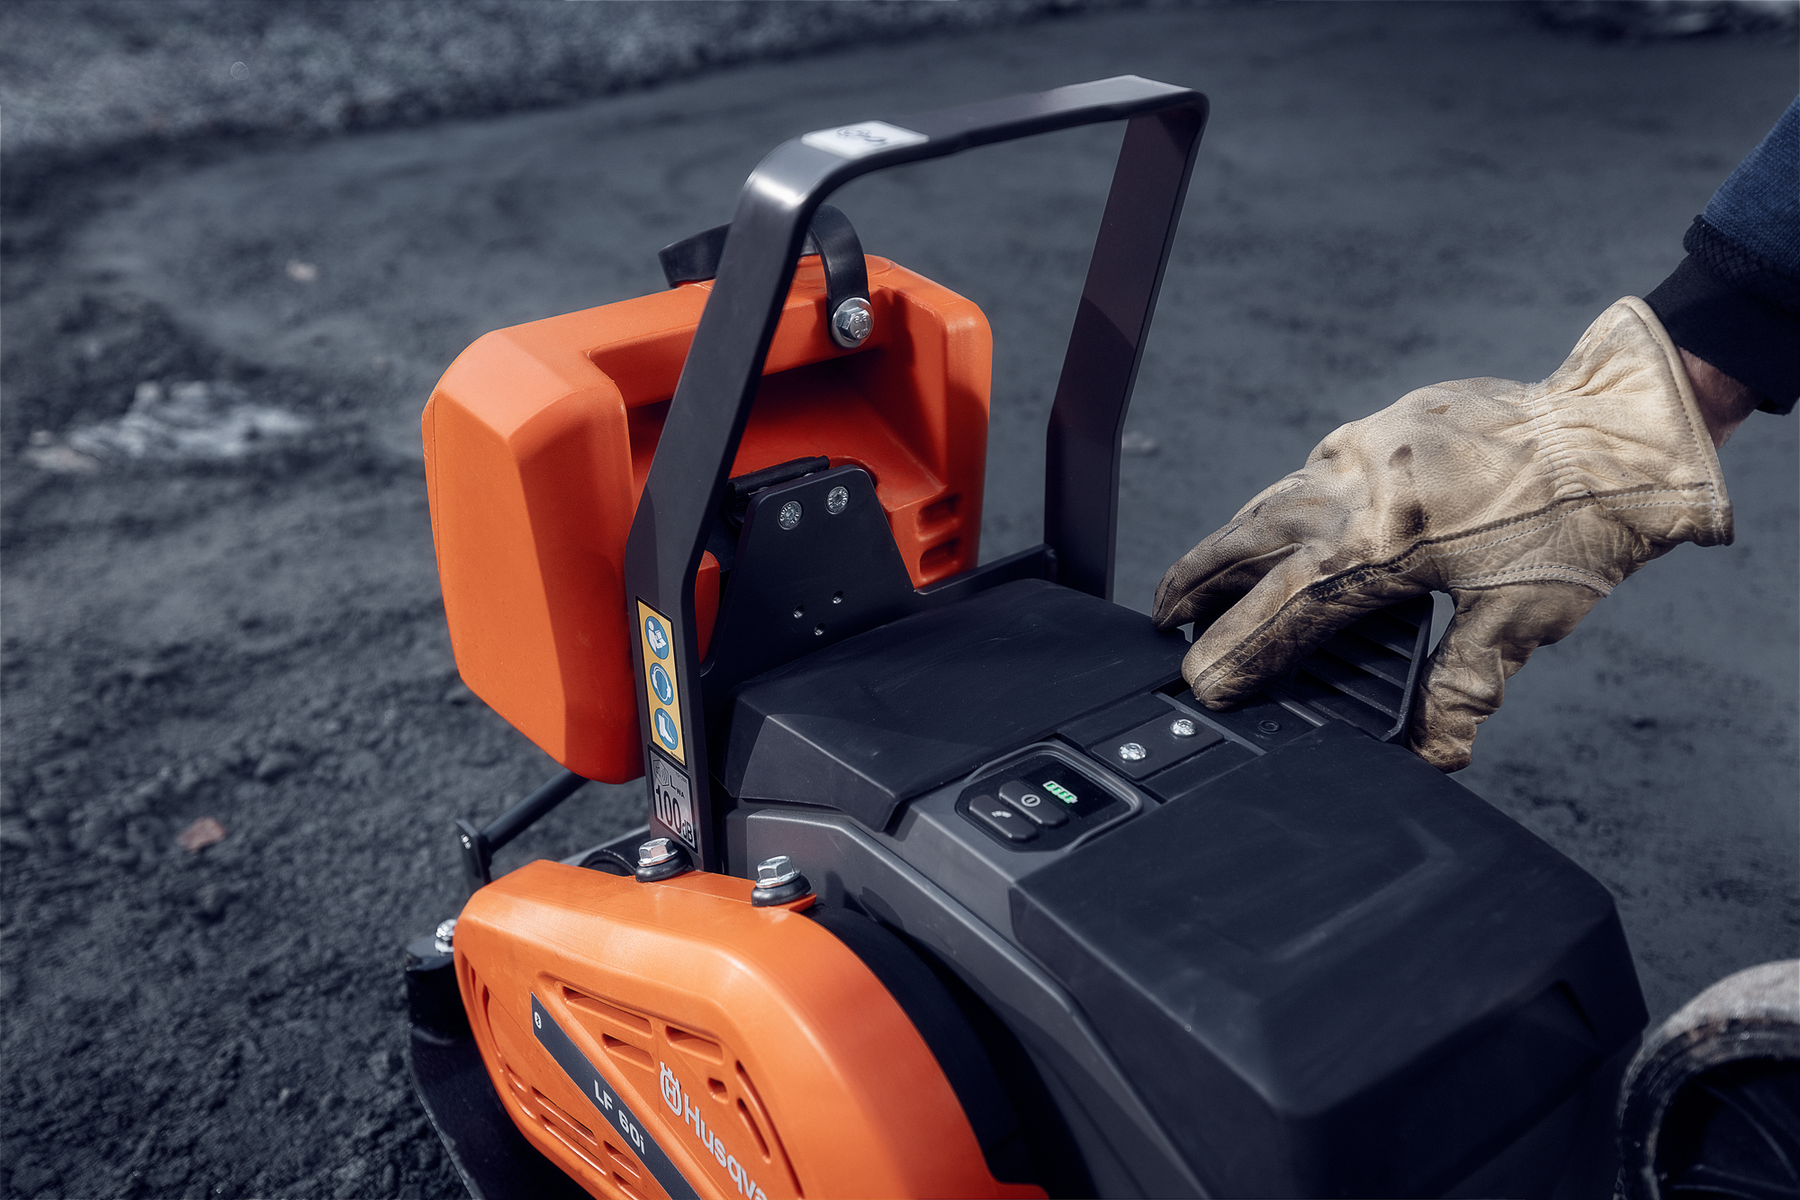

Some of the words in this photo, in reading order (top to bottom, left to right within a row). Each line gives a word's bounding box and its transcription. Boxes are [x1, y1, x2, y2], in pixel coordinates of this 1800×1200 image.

[656, 785, 681, 833] 100
[682, 820, 693, 843] dB
[594, 1080, 612, 1111] LF
[618, 1110, 645, 1154] 60i
